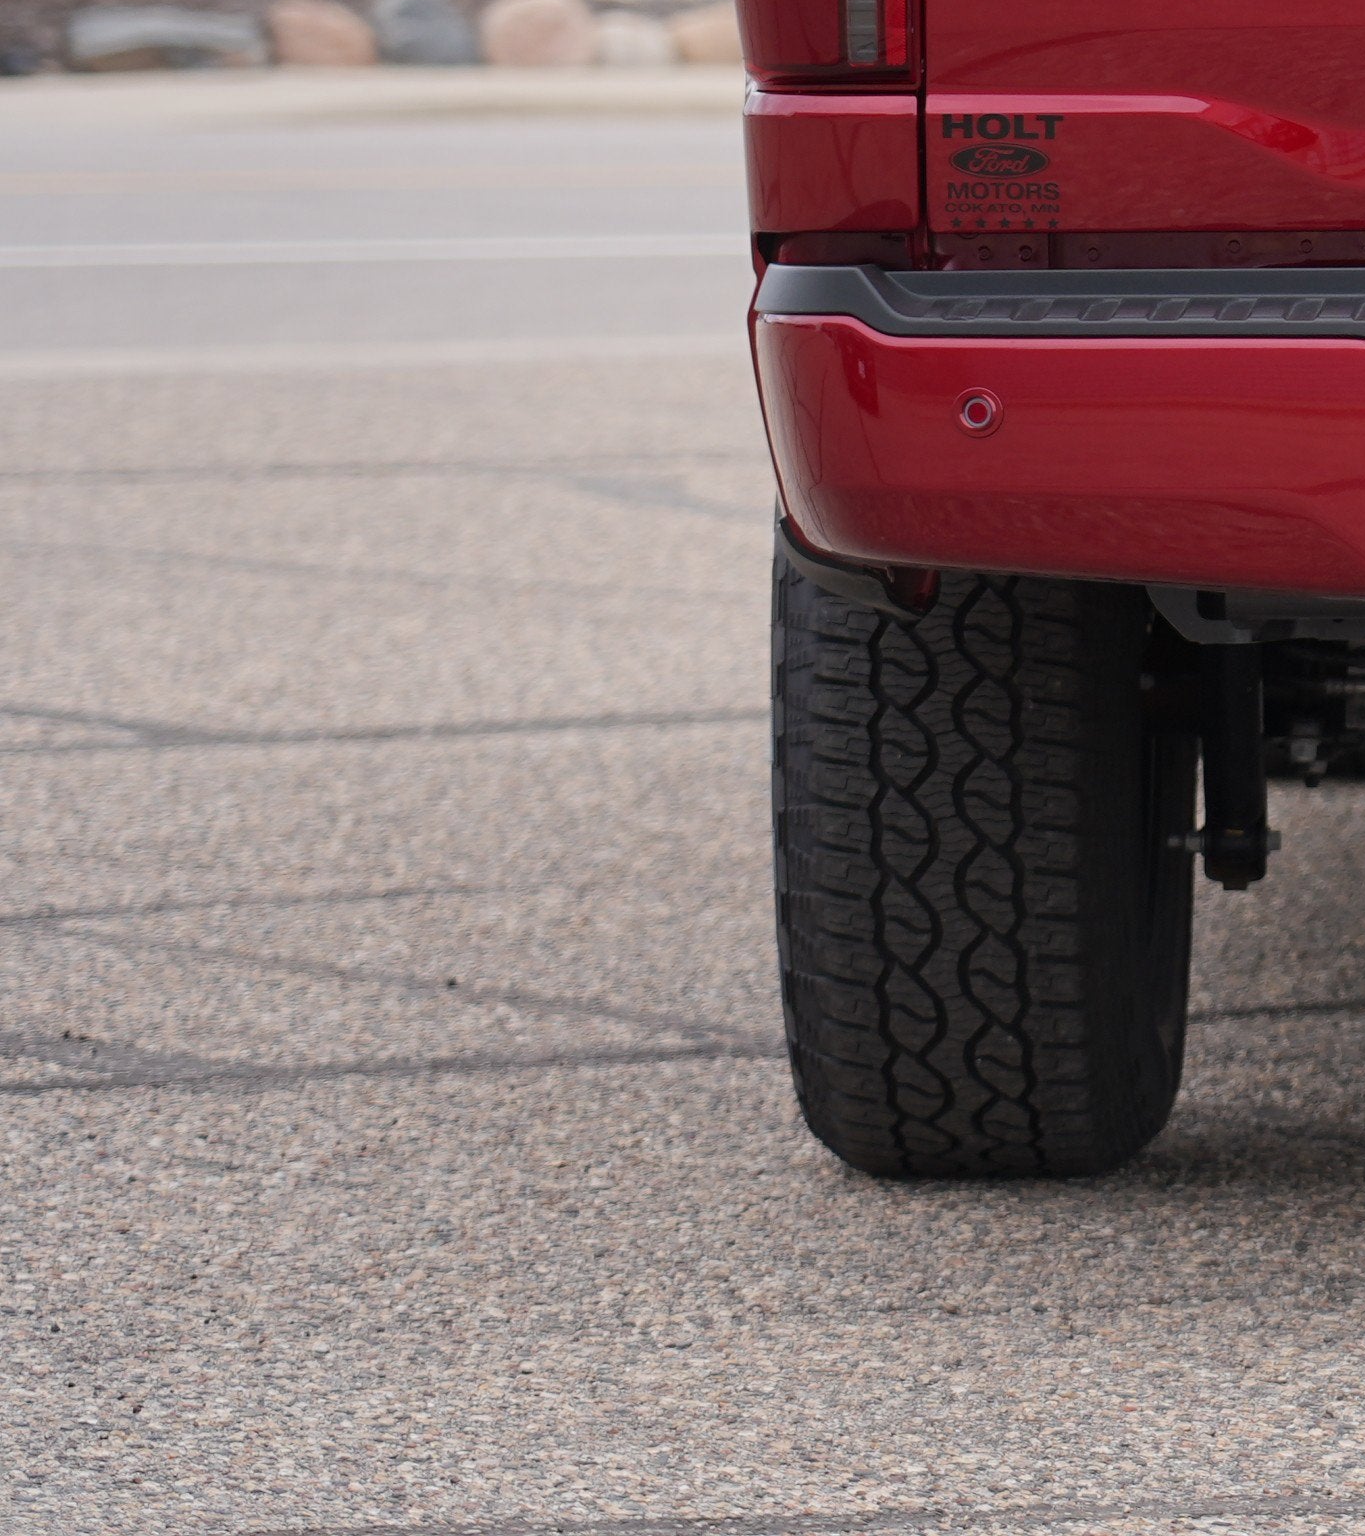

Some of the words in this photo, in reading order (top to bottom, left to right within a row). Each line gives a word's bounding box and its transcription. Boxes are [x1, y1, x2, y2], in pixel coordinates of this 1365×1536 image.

[942, 114, 1064, 140] HOLT
[968, 147, 1030, 173] Ford
[946, 182, 1060, 201] MOTORS
[944, 202, 1027, 215] COKATO,
[1031, 202, 1060, 214] MN
